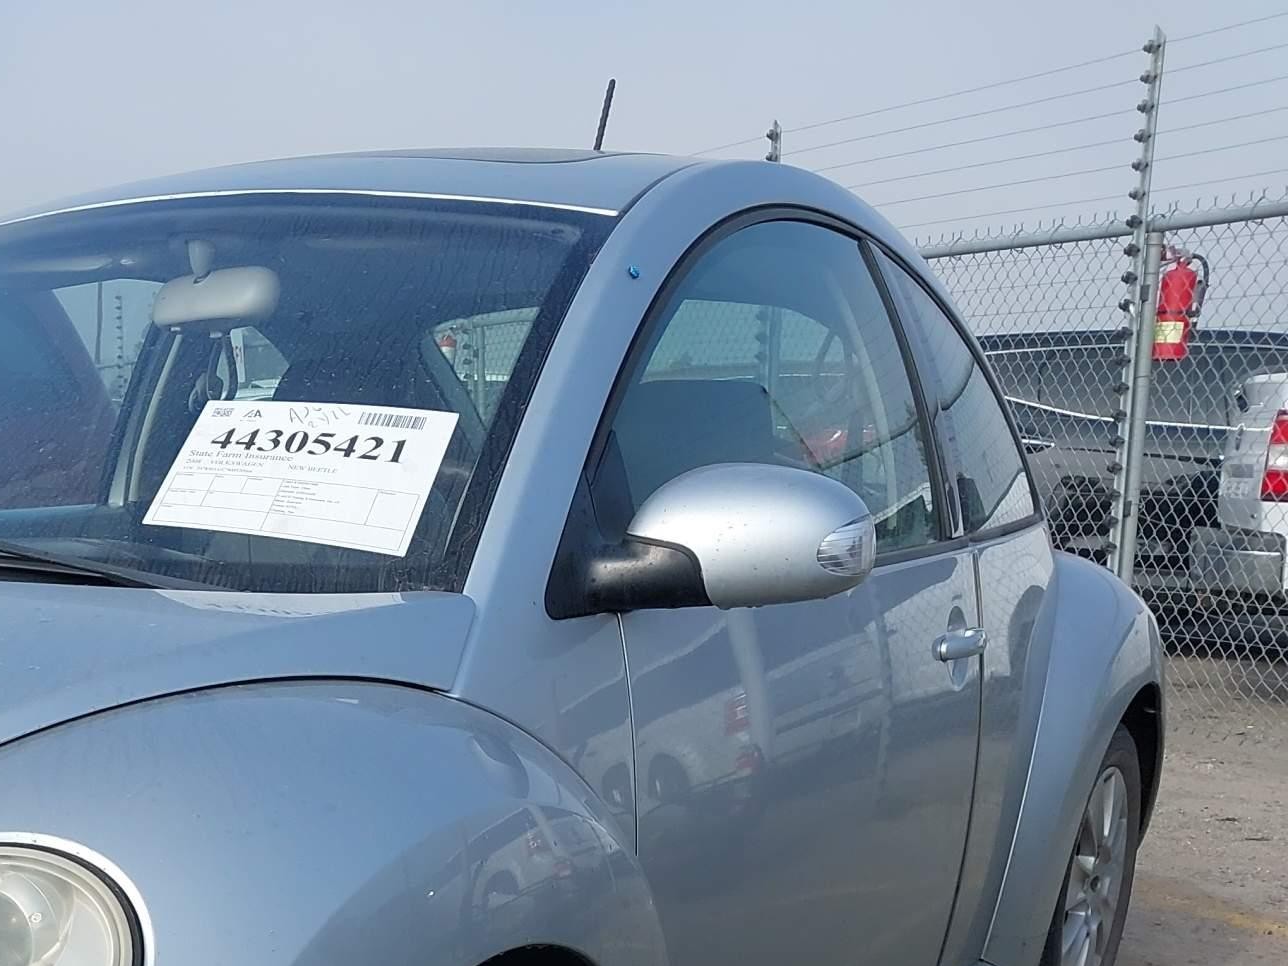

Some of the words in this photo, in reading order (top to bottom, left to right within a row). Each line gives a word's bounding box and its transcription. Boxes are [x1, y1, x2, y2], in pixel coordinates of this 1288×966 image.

[188, 449, 213, 458] State
[215, 451, 242, 460] Farm
[244, 452, 294, 463] Insurance
[210, 427, 407, 464] 44305421
